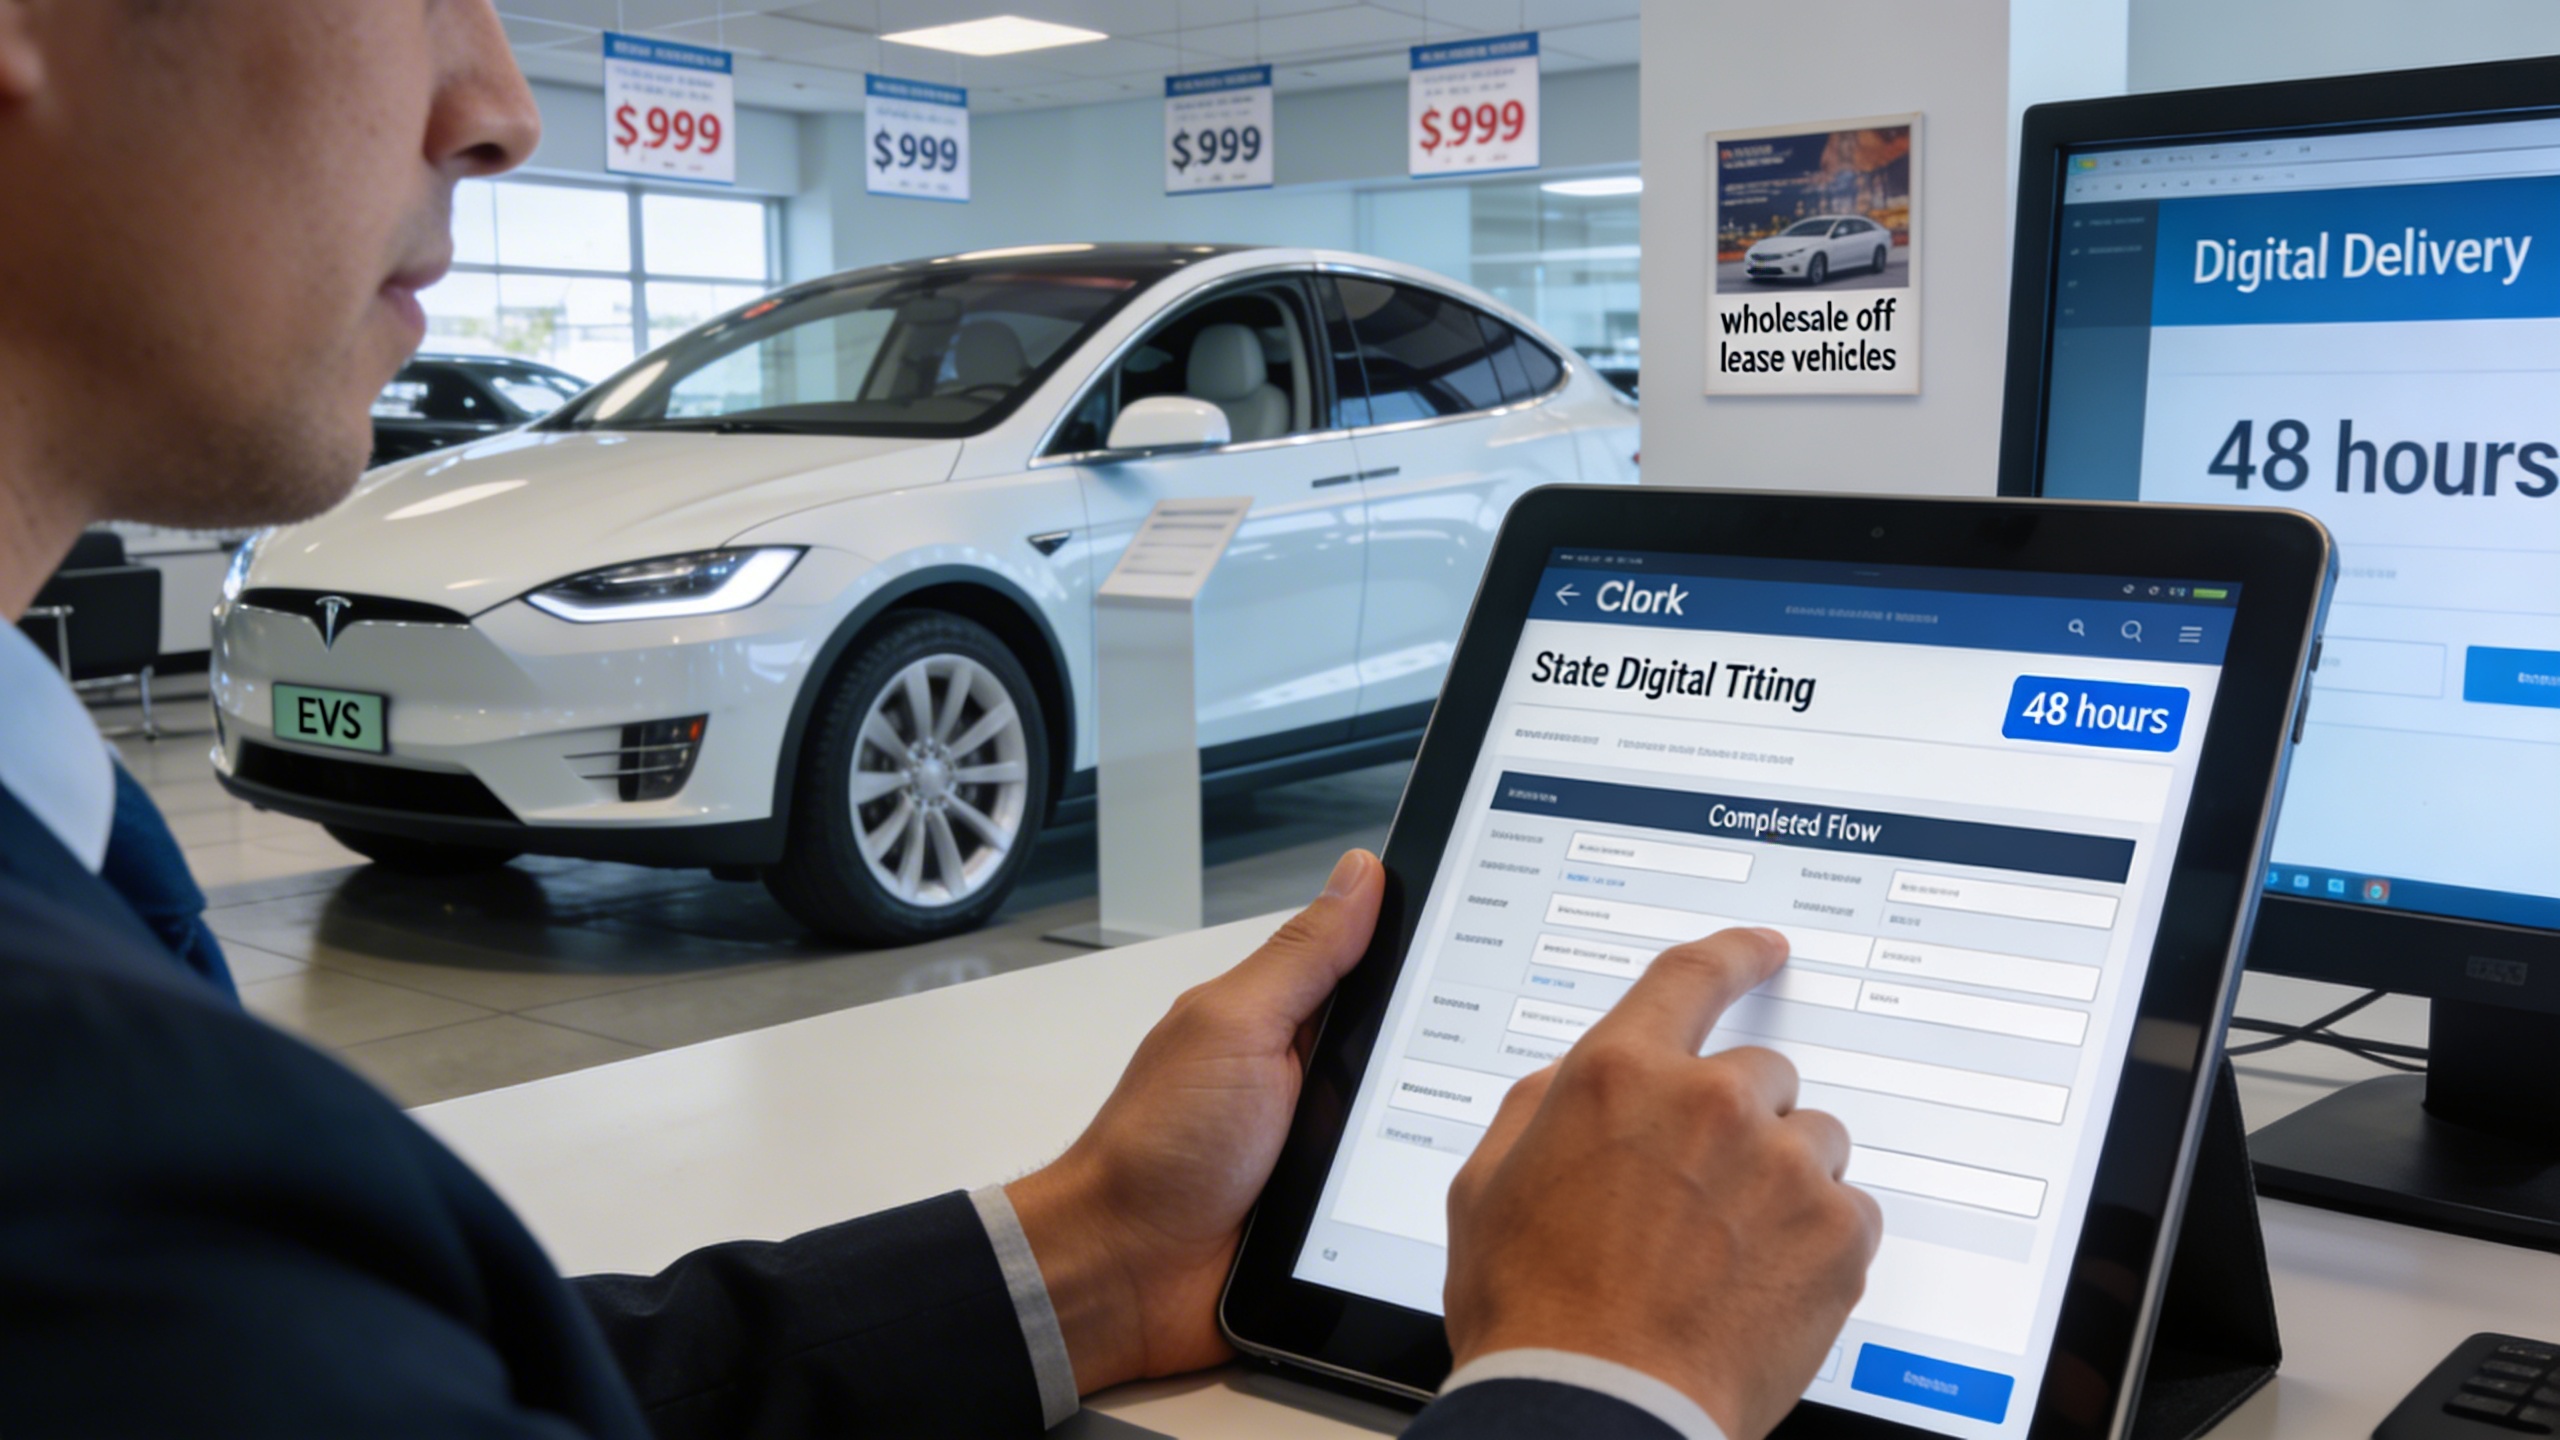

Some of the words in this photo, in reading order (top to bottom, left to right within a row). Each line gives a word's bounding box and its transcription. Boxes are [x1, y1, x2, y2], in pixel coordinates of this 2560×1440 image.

[2194, 231, 2329, 293] Digital
[2342, 227, 2533, 286] Delivery
[1720, 301, 1848, 334] wholesale
[1856, 298, 1897, 332] off
[1720, 341, 1785, 372] lease
[1792, 339, 1896, 372] vehicles
[2207, 418, 2310, 492] 48
[2335, 418, 2559, 498] hours
[1596, 579, 1689, 616] Clork
[1531, 651, 1609, 687] State
[1616, 656, 1717, 700] Digital
[1726, 663, 1816, 712] Titing
[298, 697, 362, 739] EVS
[2022, 691, 2069, 726] 48
[2075, 692, 2169, 735] hours
[1708, 804, 1822, 838] Completed
[1826, 813, 1882, 843] Flow
